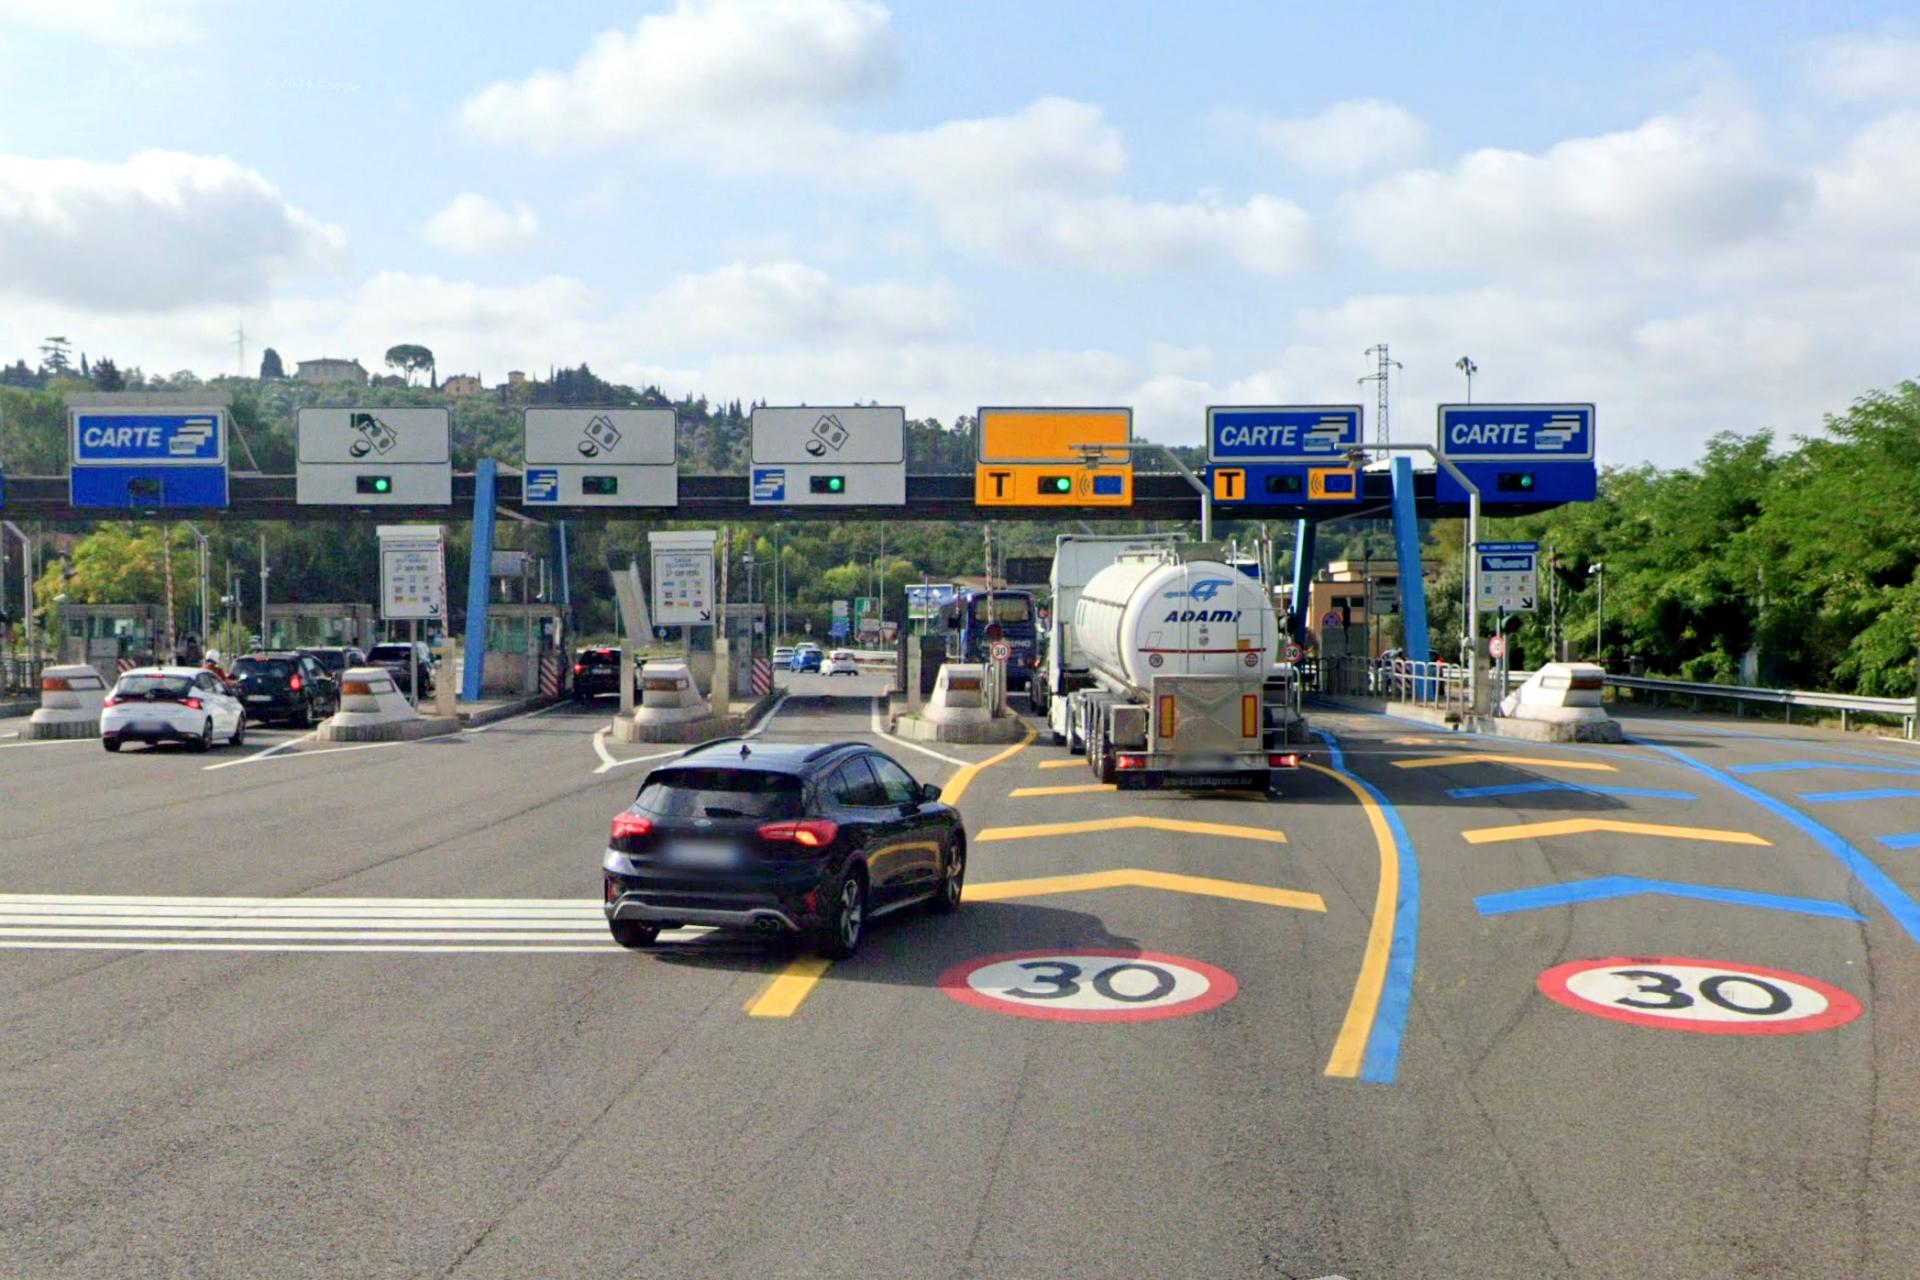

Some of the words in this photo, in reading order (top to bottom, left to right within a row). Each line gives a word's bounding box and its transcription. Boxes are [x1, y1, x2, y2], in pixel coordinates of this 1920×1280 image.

[84, 427, 163, 447] CARTE
[1220, 425, 1298, 446] CARTE
[1451, 424, 1530, 445] CARTE
[988, 472, 1011, 497] T
[1218, 472, 1241, 497] T
[1163, 610, 1242, 623] ADAMI
[995, 647, 1006, 657] 30
[1287, 648, 1299, 657] 30
[1002, 960, 1176, 1002] 30
[1610, 969, 1793, 1015] 30
